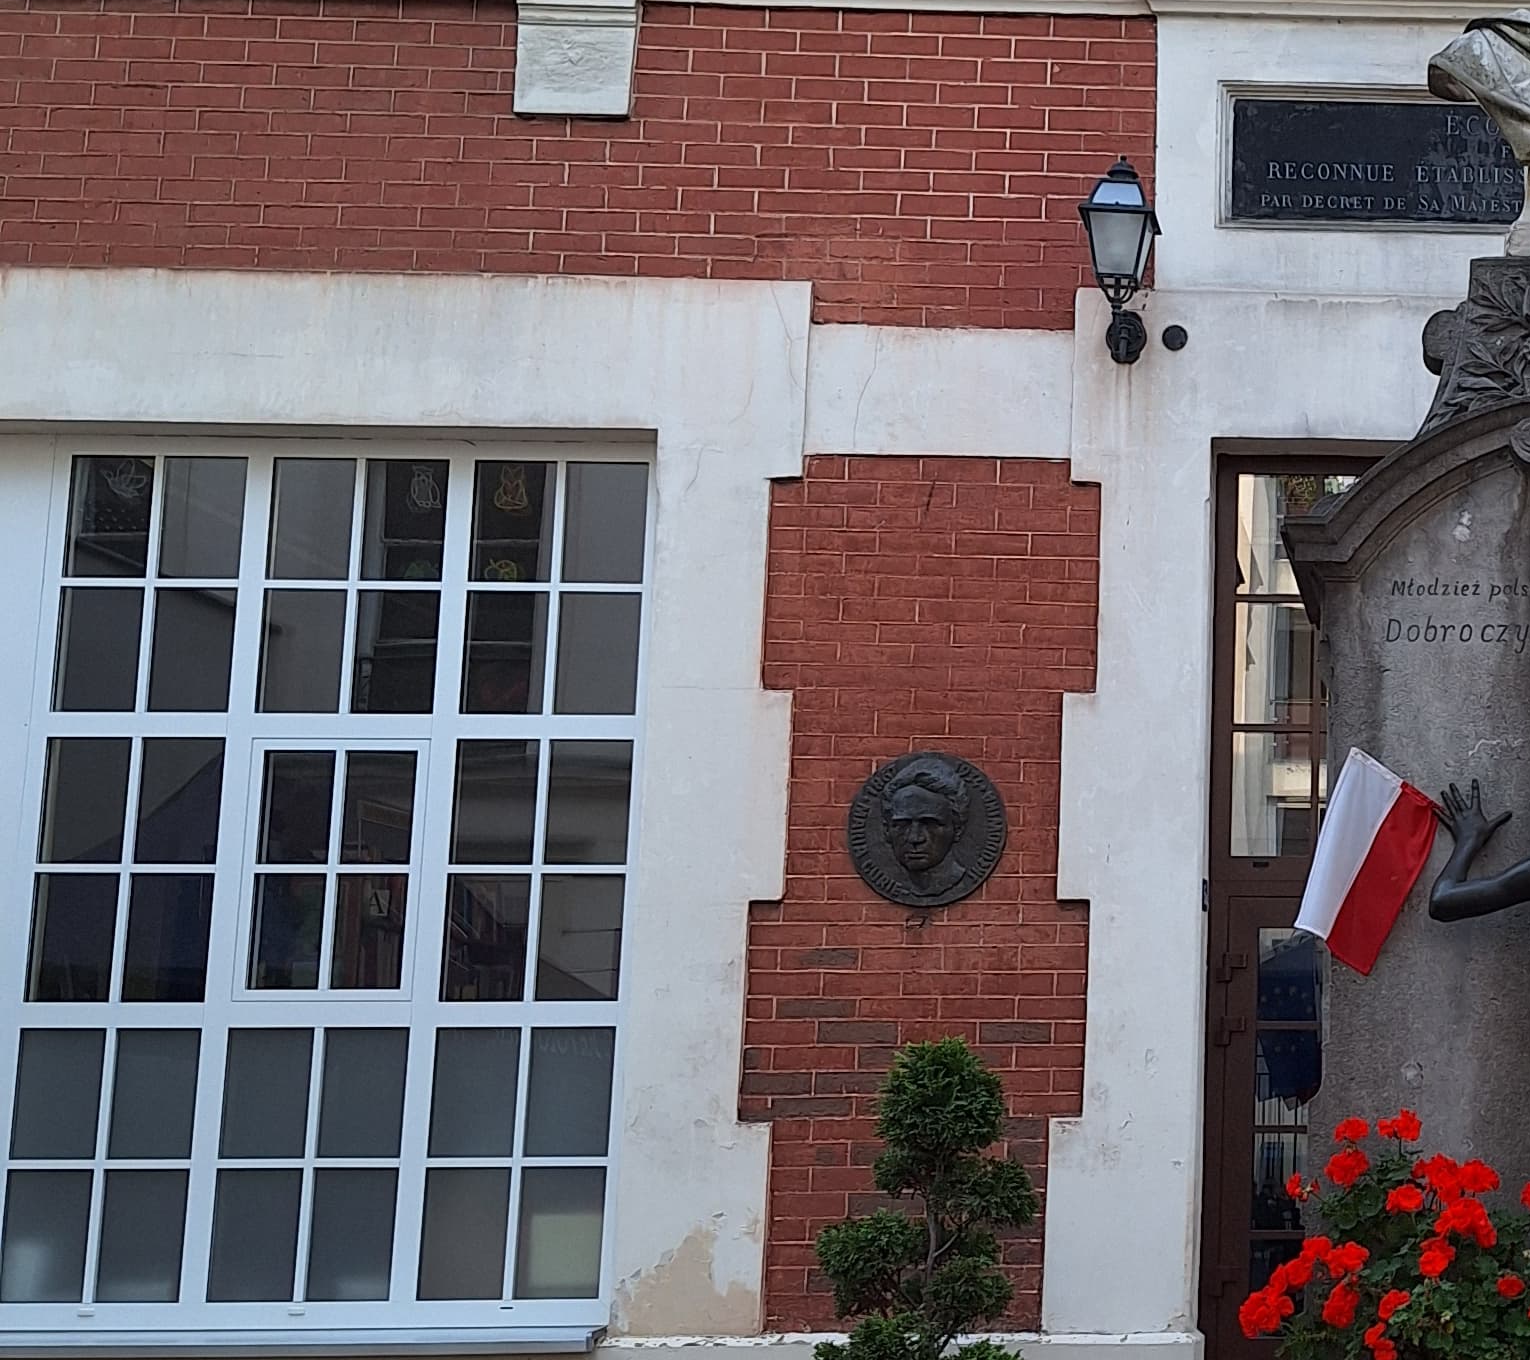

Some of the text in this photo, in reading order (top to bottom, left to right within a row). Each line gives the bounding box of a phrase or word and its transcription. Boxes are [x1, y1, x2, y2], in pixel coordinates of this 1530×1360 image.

[1267, 161, 1395, 182] RECONNUE
[1261, 194, 1293, 208] PAR
[1383, 197, 1407, 210] DE
